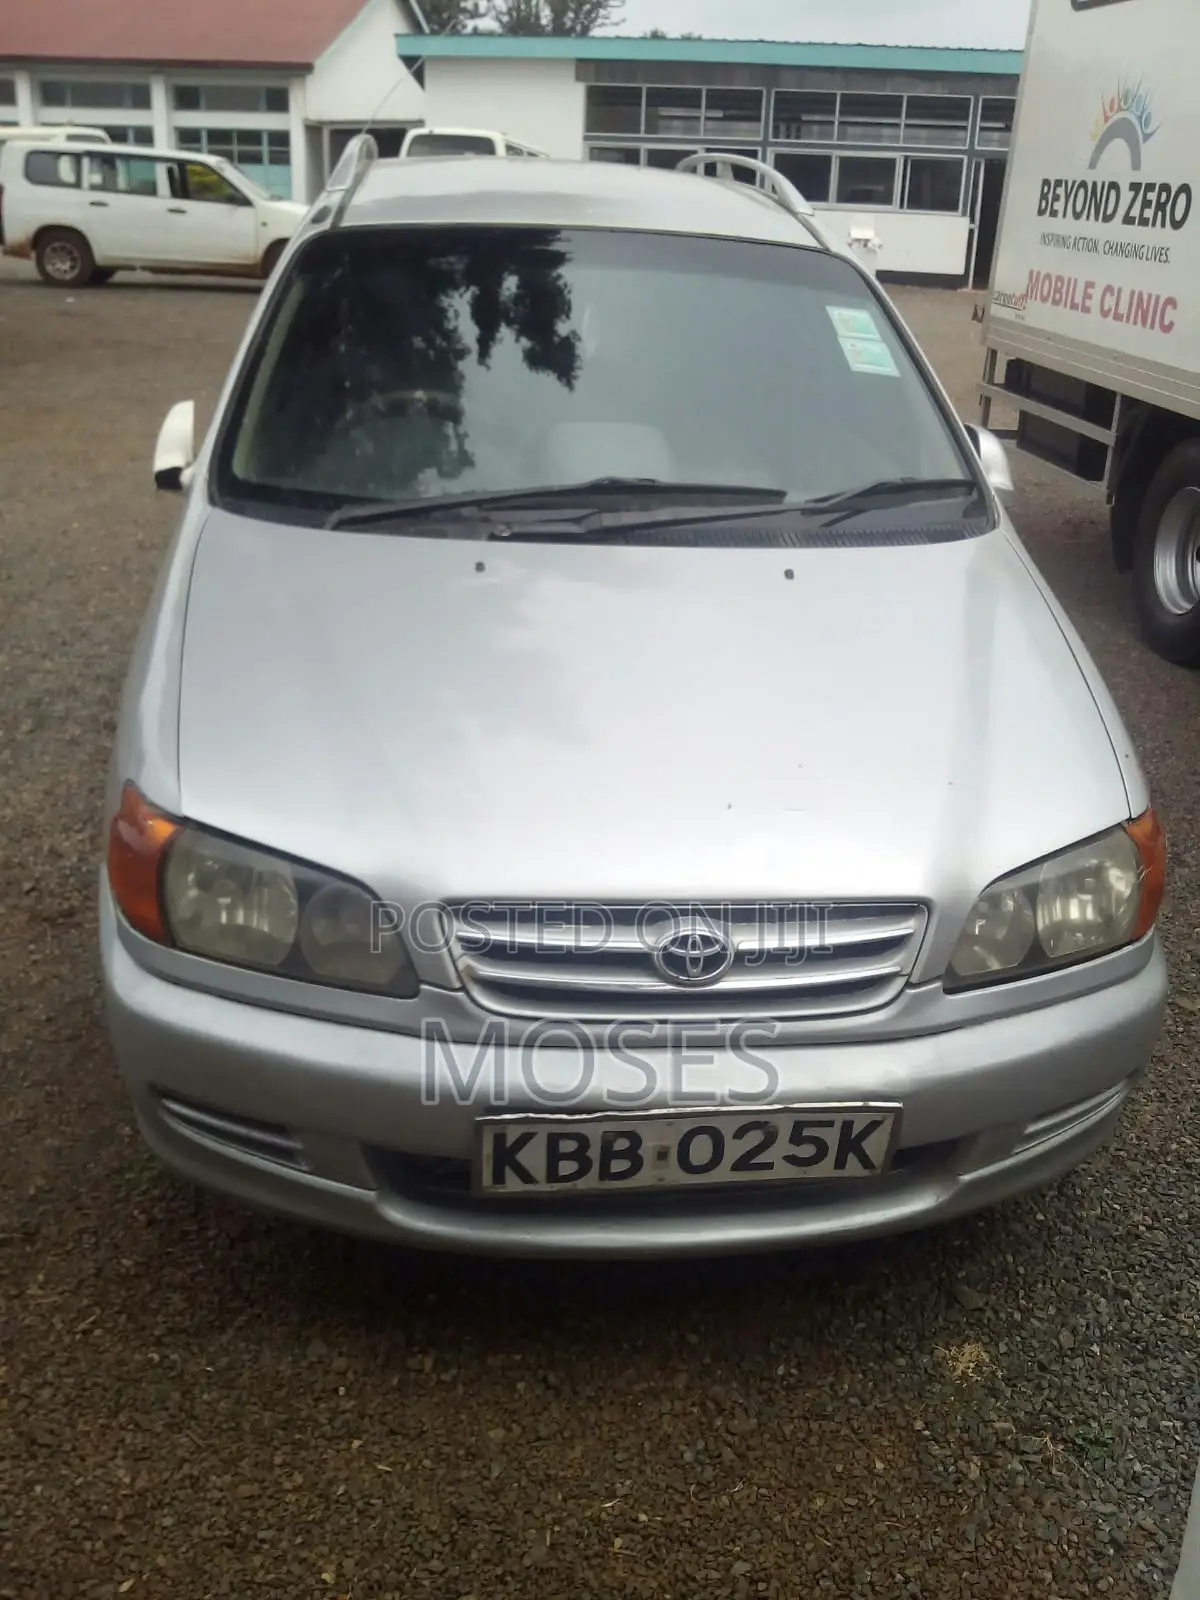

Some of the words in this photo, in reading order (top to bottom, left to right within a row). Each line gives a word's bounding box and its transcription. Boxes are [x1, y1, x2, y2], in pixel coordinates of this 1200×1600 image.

[1037, 178, 1121, 223] BEYOND
[1122, 182, 1192, 230] ZERO
[1040, 232, 1071, 249] INSPIRING
[1103, 239, 1145, 260] CHANGING
[1146, 246, 1171, 264] LIVES.
[1027, 269, 1095, 313] MOBILE
[1100, 284, 1177, 333] CLINIC
[491, 1129, 645, 1186] KBB
[677, 1119, 884, 1175] 025K
